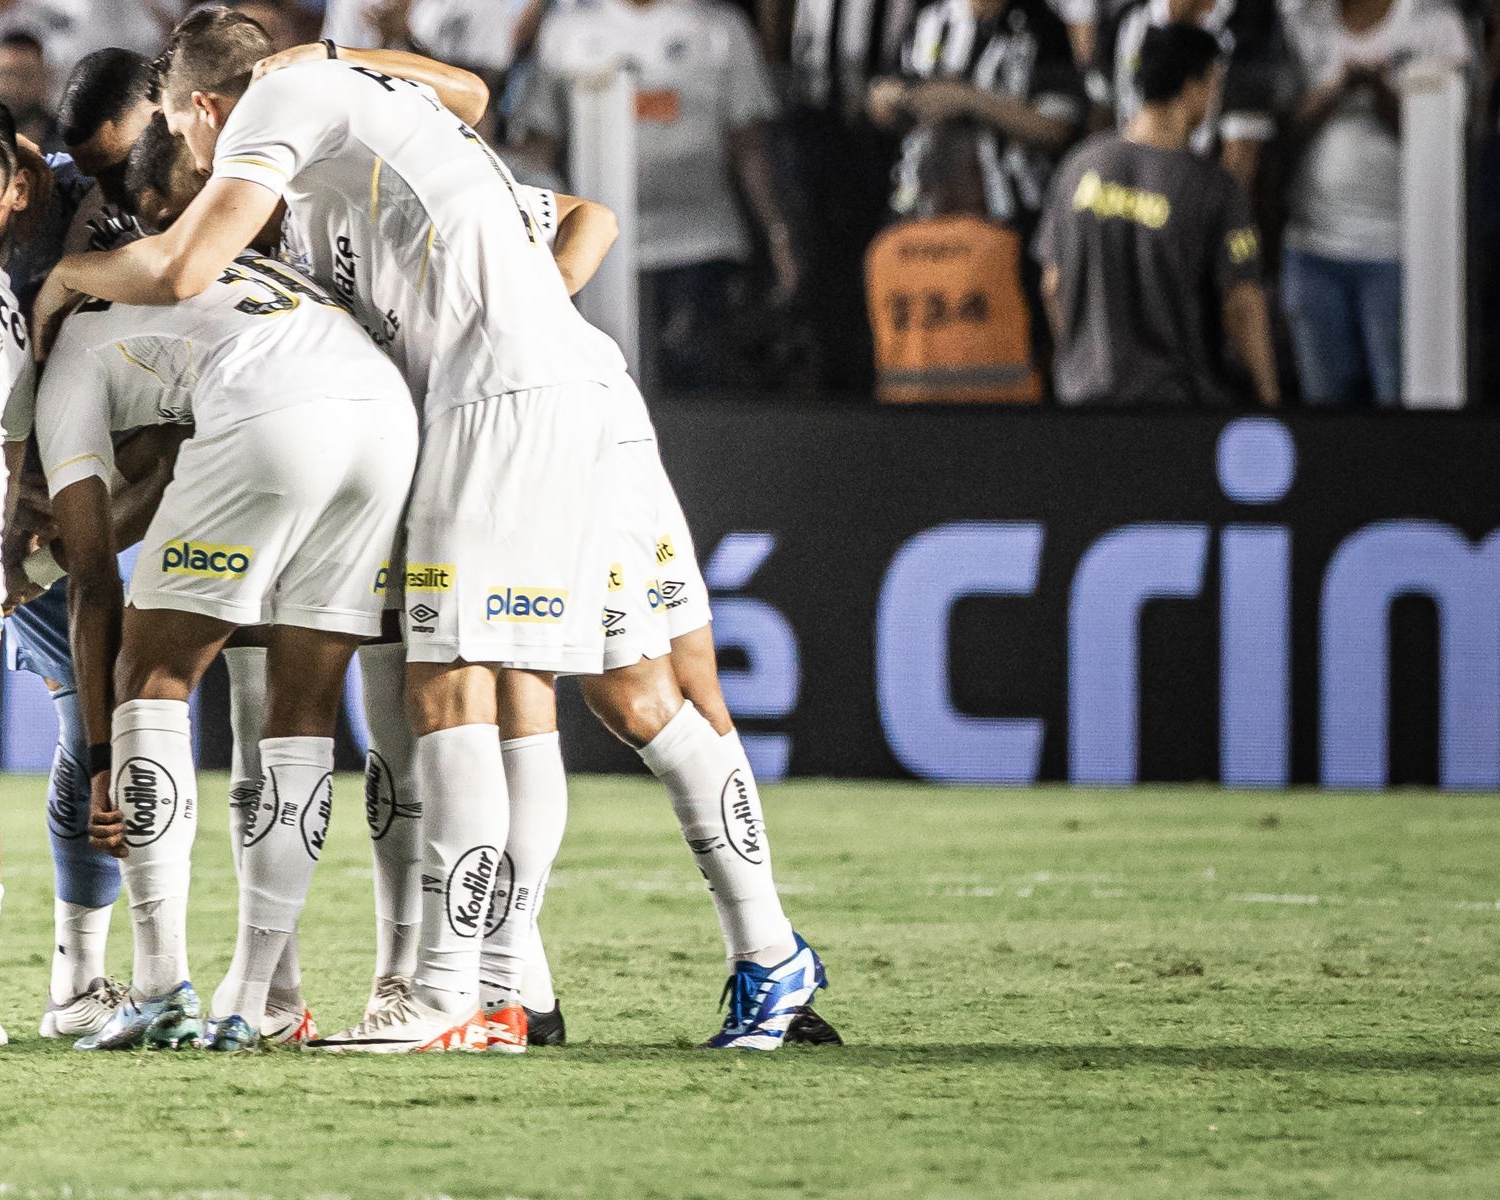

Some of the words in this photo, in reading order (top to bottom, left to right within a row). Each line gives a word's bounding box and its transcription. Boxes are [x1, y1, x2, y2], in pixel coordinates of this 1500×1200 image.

[162, 542, 249, 573] placo
[486, 588, 564, 620] placo
[124, 764, 157, 837] Kodilar
[455, 851, 494, 929] Kodilar
